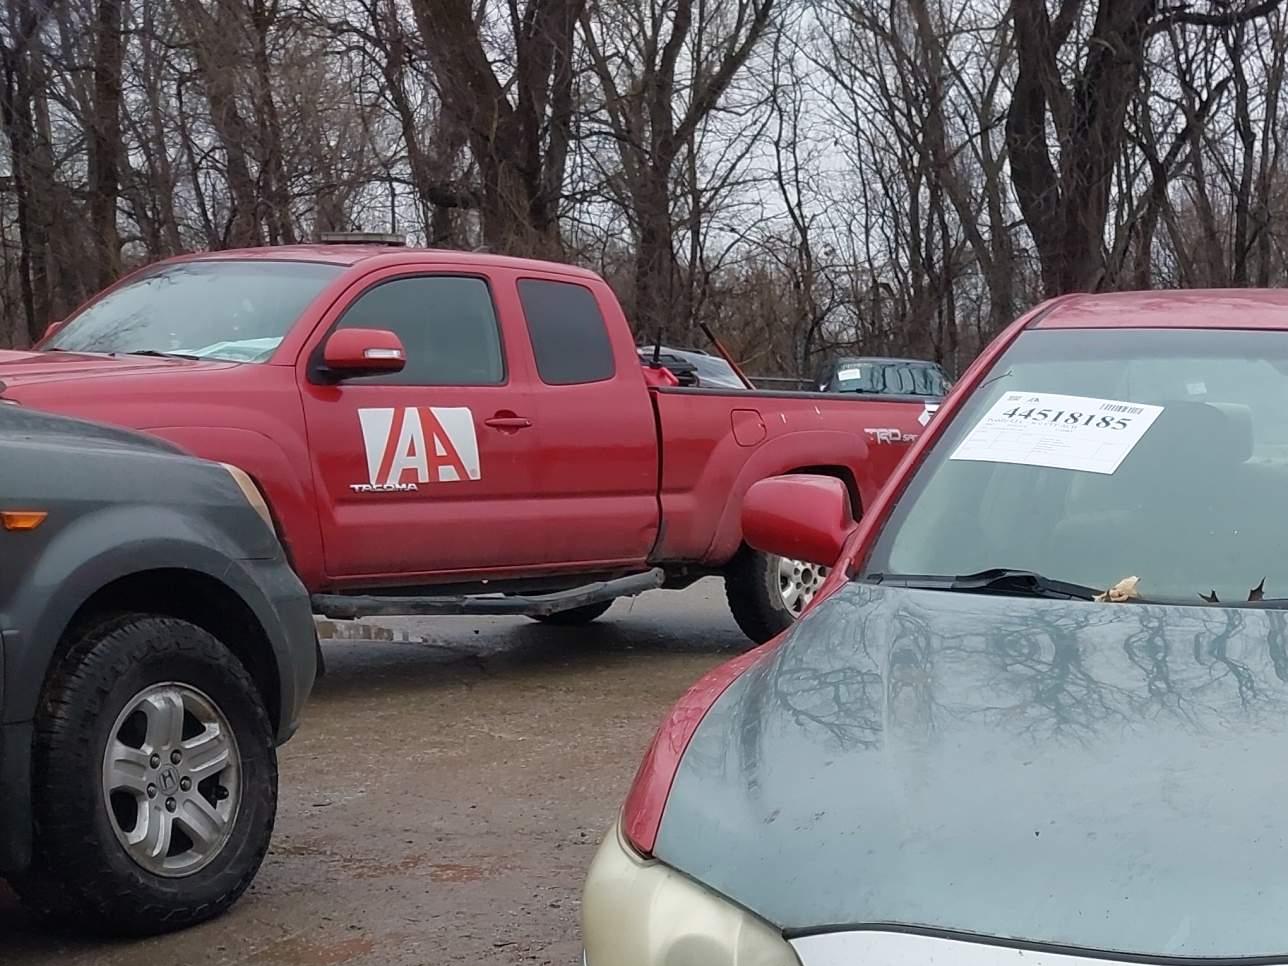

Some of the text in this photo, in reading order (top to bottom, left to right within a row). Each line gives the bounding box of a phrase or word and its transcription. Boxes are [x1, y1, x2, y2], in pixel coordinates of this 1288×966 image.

[1003, 406, 1131, 431] 44518185
[864, 428, 901, 444] TRD
[350, 483, 419, 492] TACOMA
